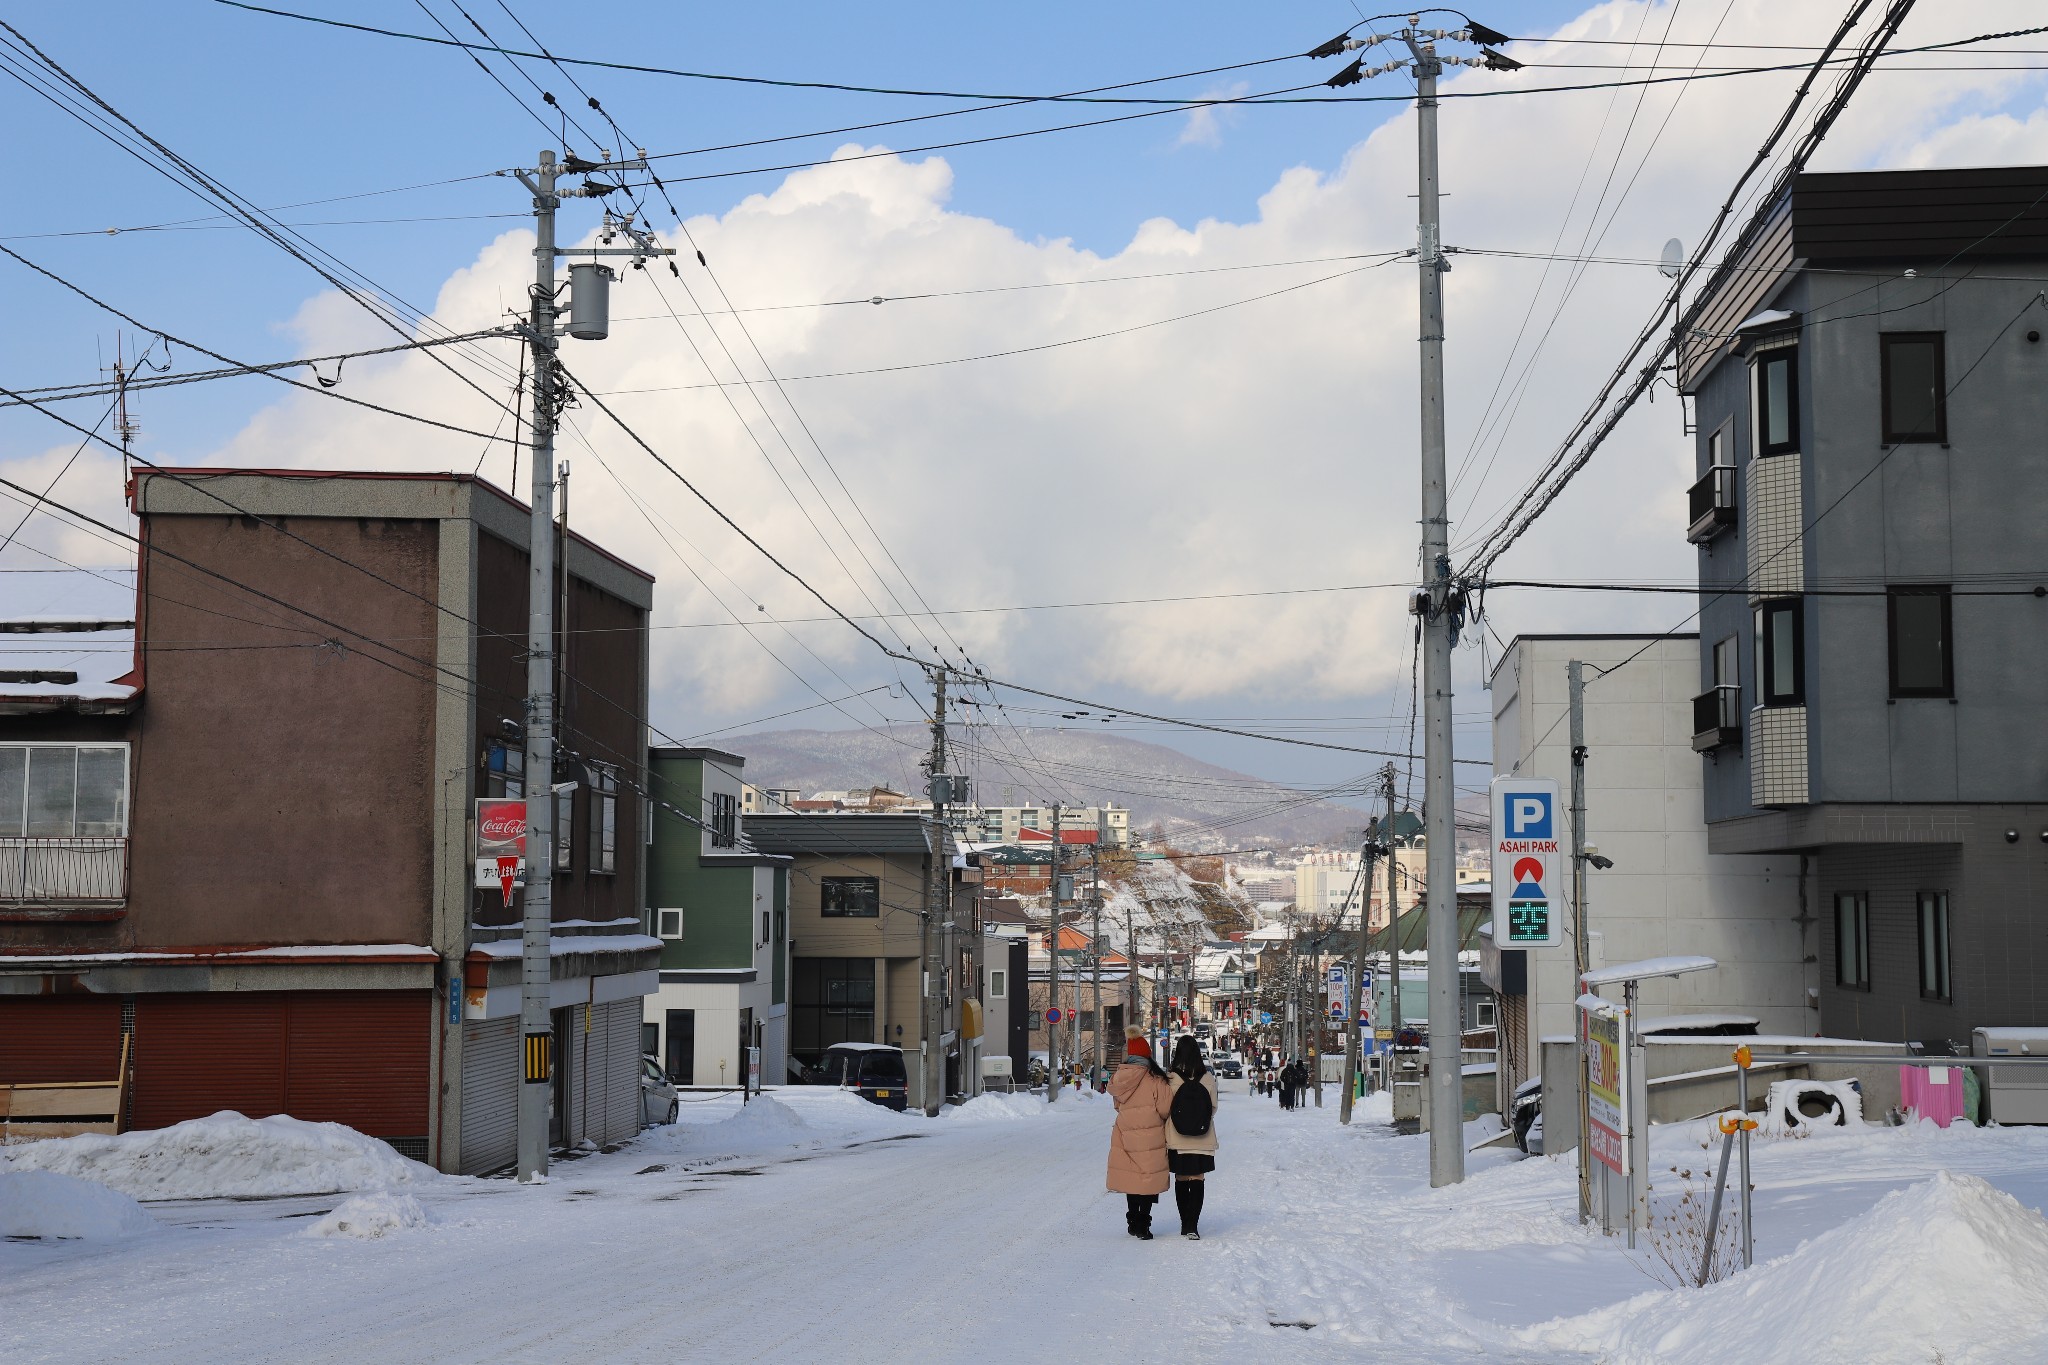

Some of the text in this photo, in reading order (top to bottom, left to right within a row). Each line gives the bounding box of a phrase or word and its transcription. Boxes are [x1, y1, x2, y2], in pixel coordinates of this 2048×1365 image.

[1513, 798, 1545, 833] P
[481, 819, 527, 834] Coca-Cola
[1499, 841, 1558, 853] ASAHI PARK
[500, 864, 515, 877] 止まれ
[1510, 902, 1549, 940] 空
[1330, 970, 1342, 981] P
[1330, 982, 1343, 991] 100円
